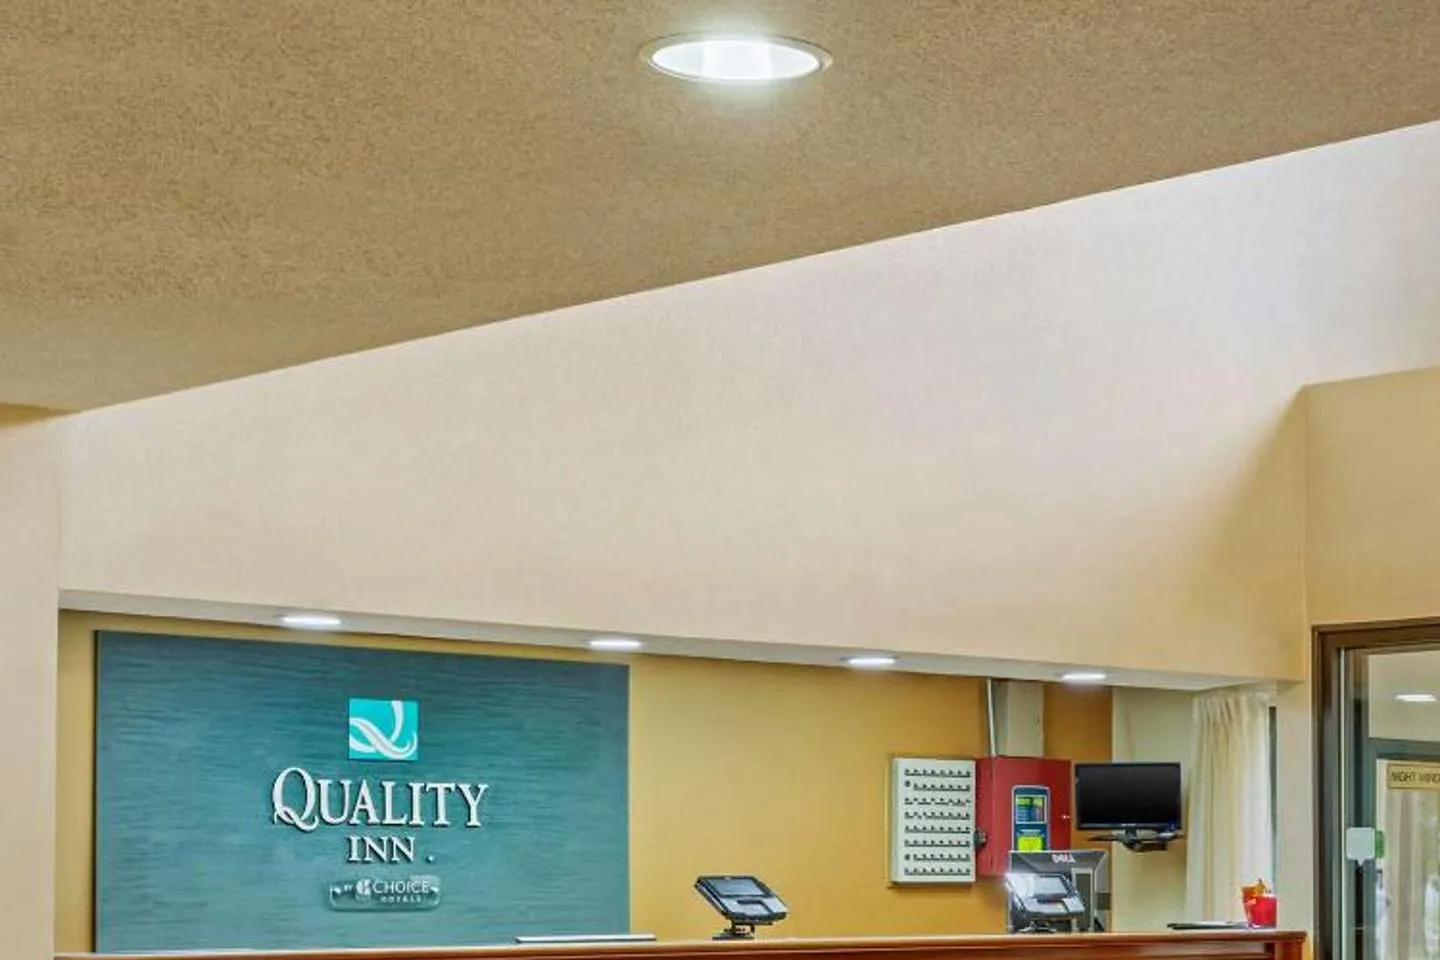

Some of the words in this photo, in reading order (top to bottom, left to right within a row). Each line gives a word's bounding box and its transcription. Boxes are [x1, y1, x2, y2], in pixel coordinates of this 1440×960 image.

[272, 767, 489, 832] QUALITY
[348, 836, 416, 862] INN
[372, 880, 429, 893] CHOICE
